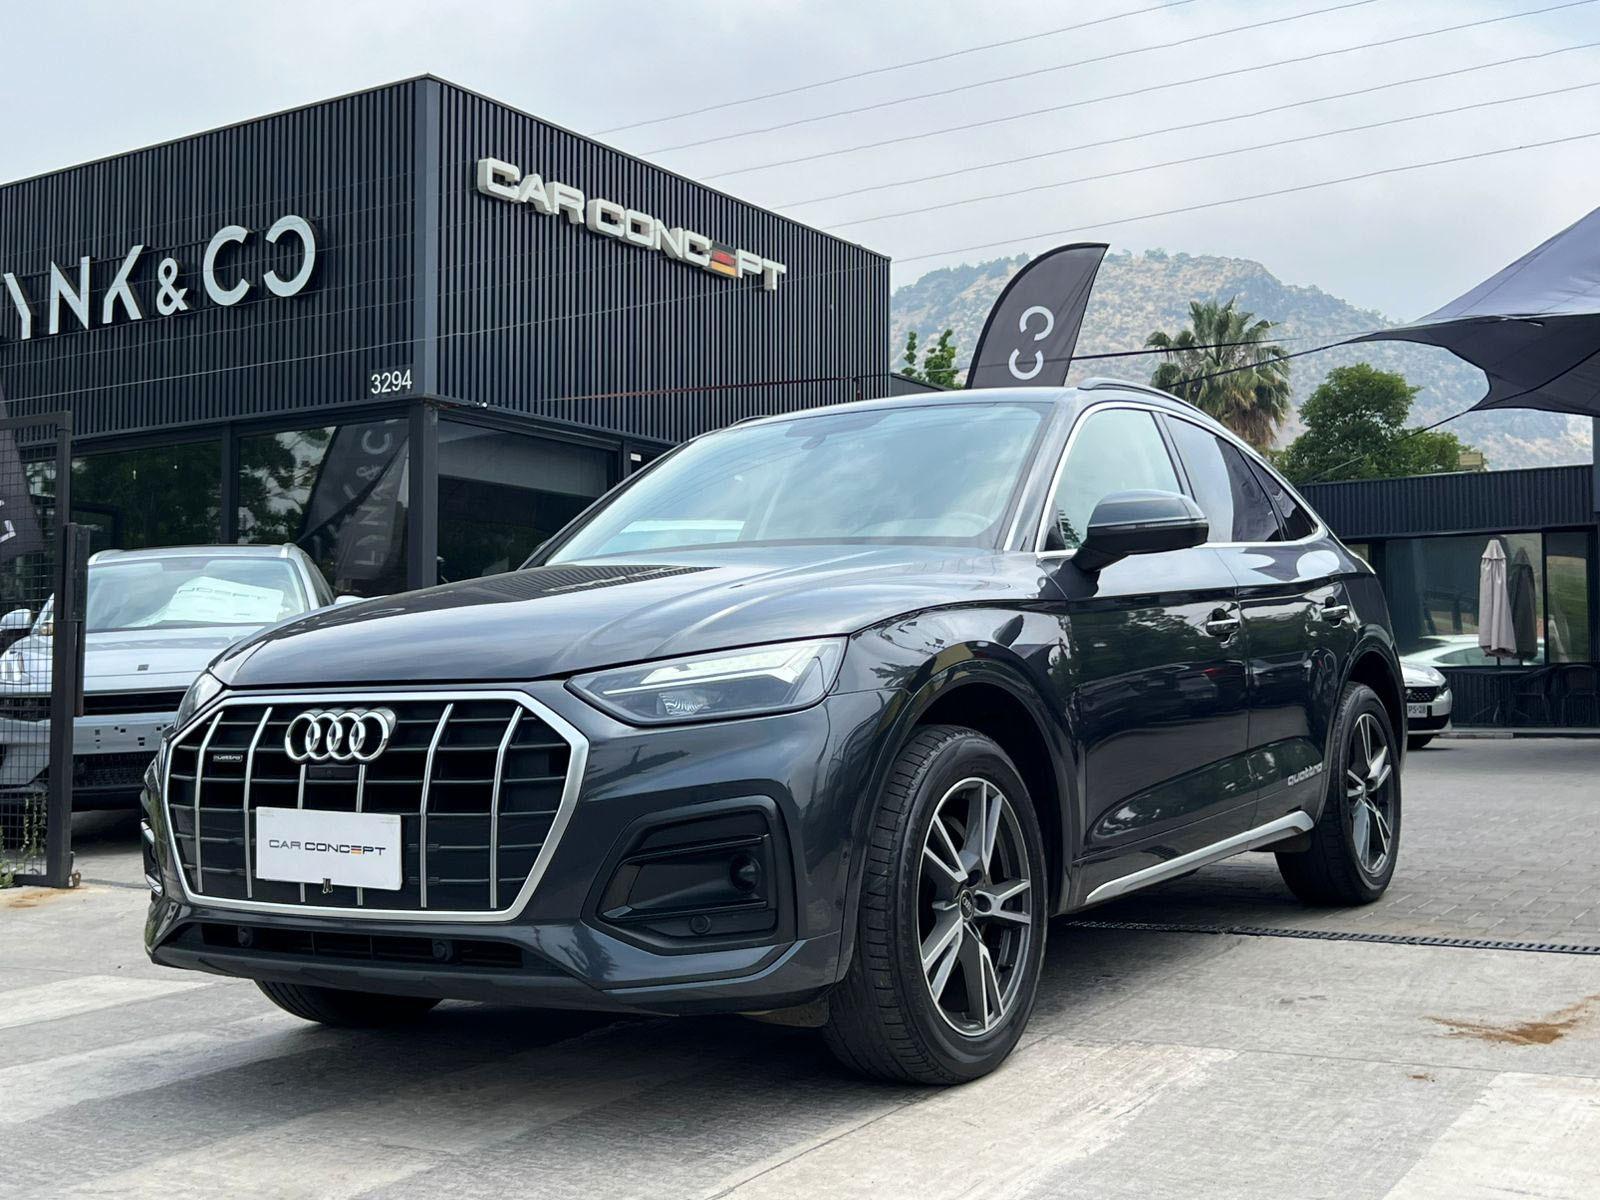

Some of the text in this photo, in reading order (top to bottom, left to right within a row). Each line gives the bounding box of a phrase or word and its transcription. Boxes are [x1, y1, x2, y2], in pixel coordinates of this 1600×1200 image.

[478, 157, 786, 291] CAR CONCEPT
[156, 257, 189, 316] &
[371, 369, 412, 394] 3294
[1287, 761, 1323, 786] quattro
[269, 839, 386, 855] CAR CONCEPT
